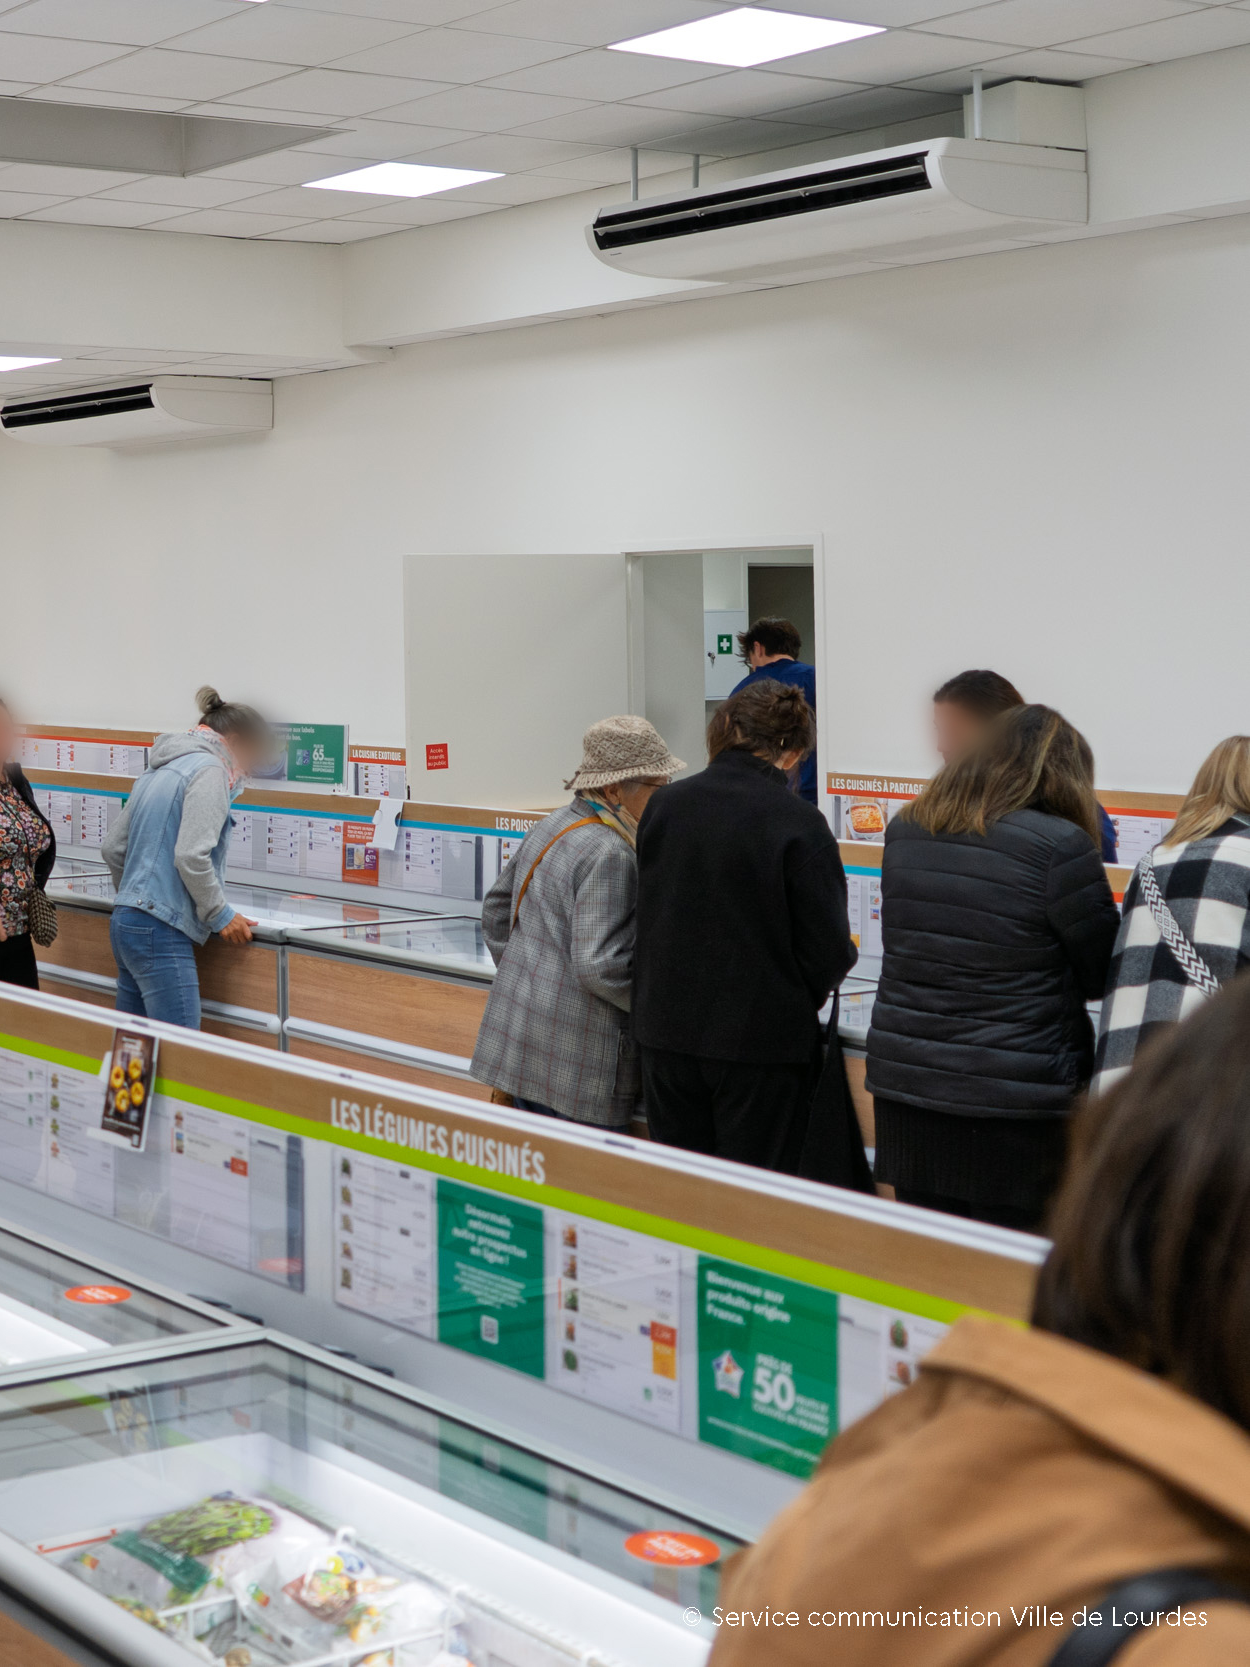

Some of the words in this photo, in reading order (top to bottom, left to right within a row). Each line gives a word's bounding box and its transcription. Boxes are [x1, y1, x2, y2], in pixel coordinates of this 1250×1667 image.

[312, 749, 324, 761] 65
[352, 749, 358, 758] LA
[358, 750, 378, 760] CUISINE
[378, 751, 402, 761] EXOTIQUE
[831, 778, 845, 789] LES
[846, 778, 882, 792] CUISINÉS
[883, 779, 889, 792] À
[889, 782, 926, 795] PARTAGE
[495, 816, 510, 830] LES
[330, 1097, 361, 1134] LES
[364, 1103, 449, 1158] LÉGUMES
[452, 1129, 546, 1185] CUISINÉS
[477, 1235, 528, 1259] prospectus
[706, 1269, 762, 1297] Bienvenue
[764, 1289, 785, 1305] aux
[706, 1289, 752, 1311] produits
[753, 1303, 791, 1324] origine
[706, 1303, 746, 1325] France.
[753, 1366, 796, 1413] 50
